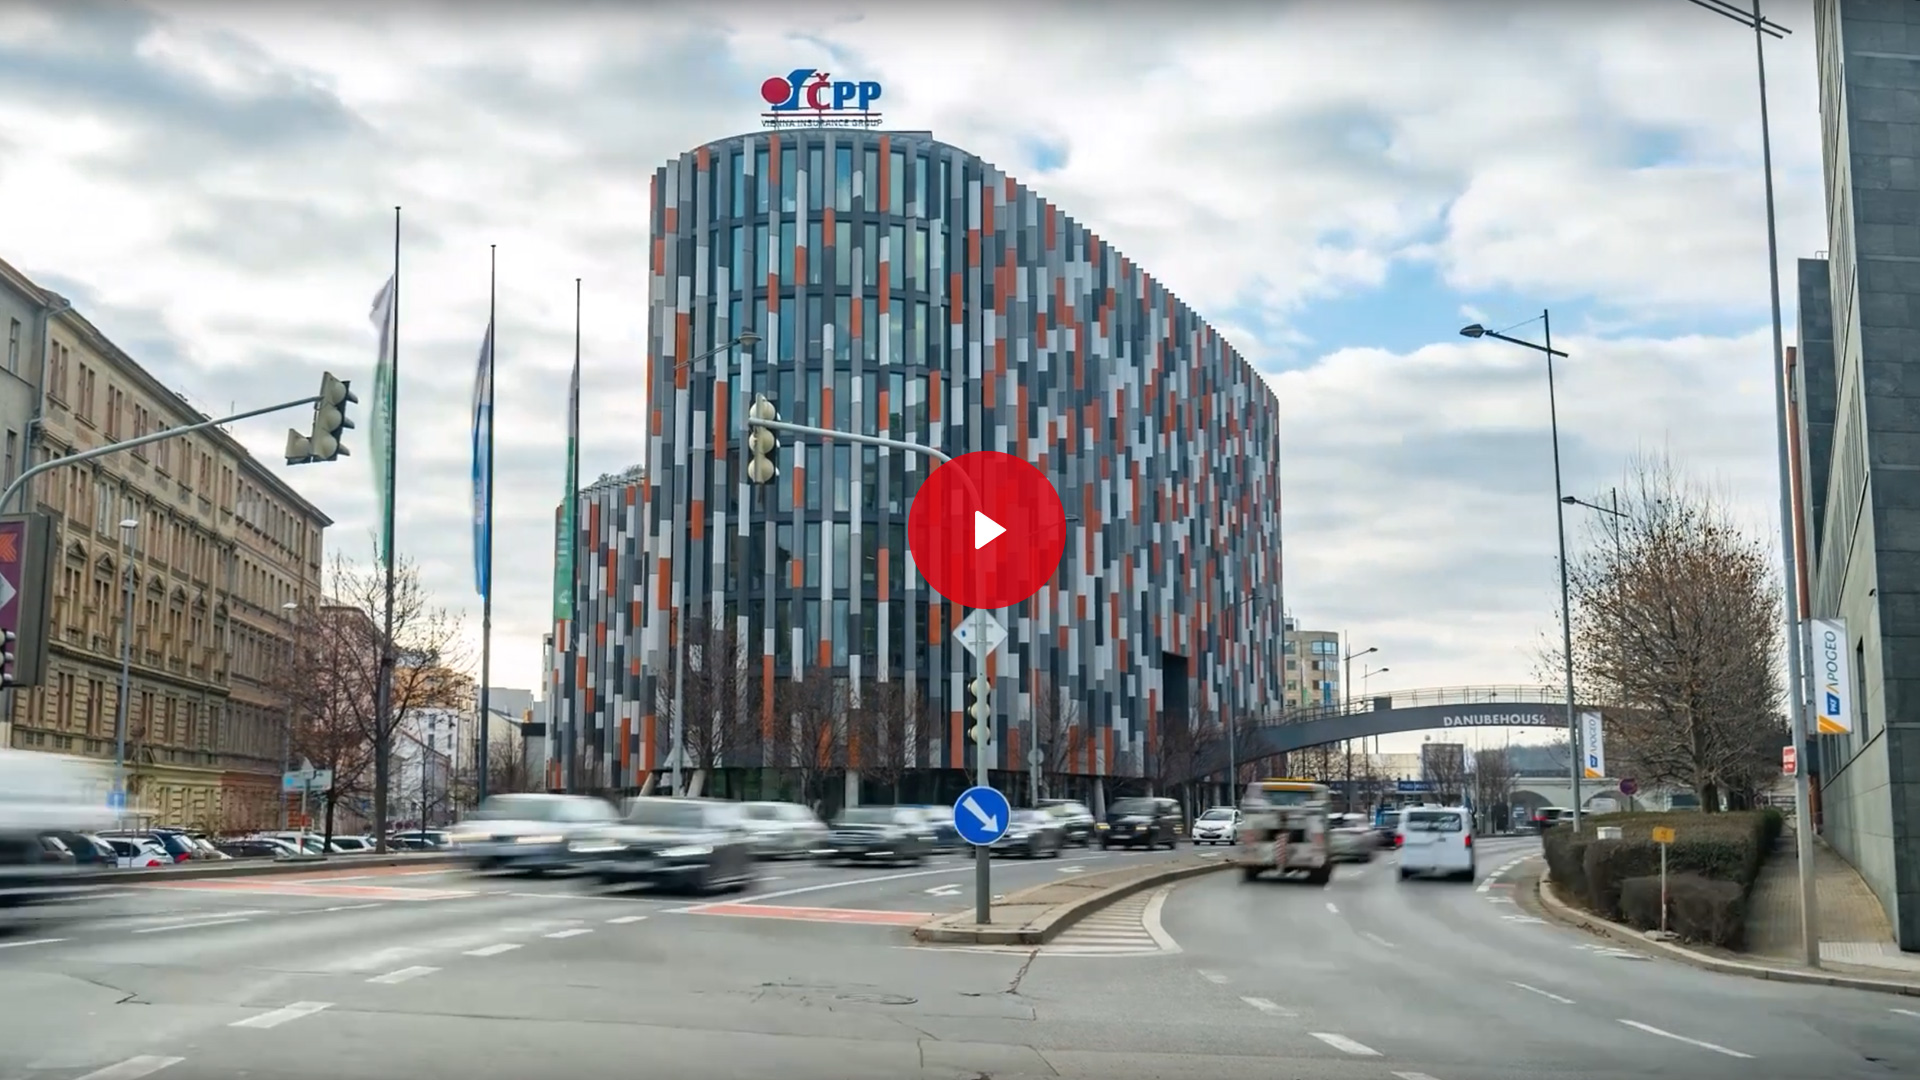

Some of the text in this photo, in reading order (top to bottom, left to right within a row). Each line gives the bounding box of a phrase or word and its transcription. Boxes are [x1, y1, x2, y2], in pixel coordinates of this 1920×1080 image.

[806, 73, 882, 110] ČPP
[852, 119, 883, 127] GROUP
[1824, 630, 1839, 694] APOGEO
